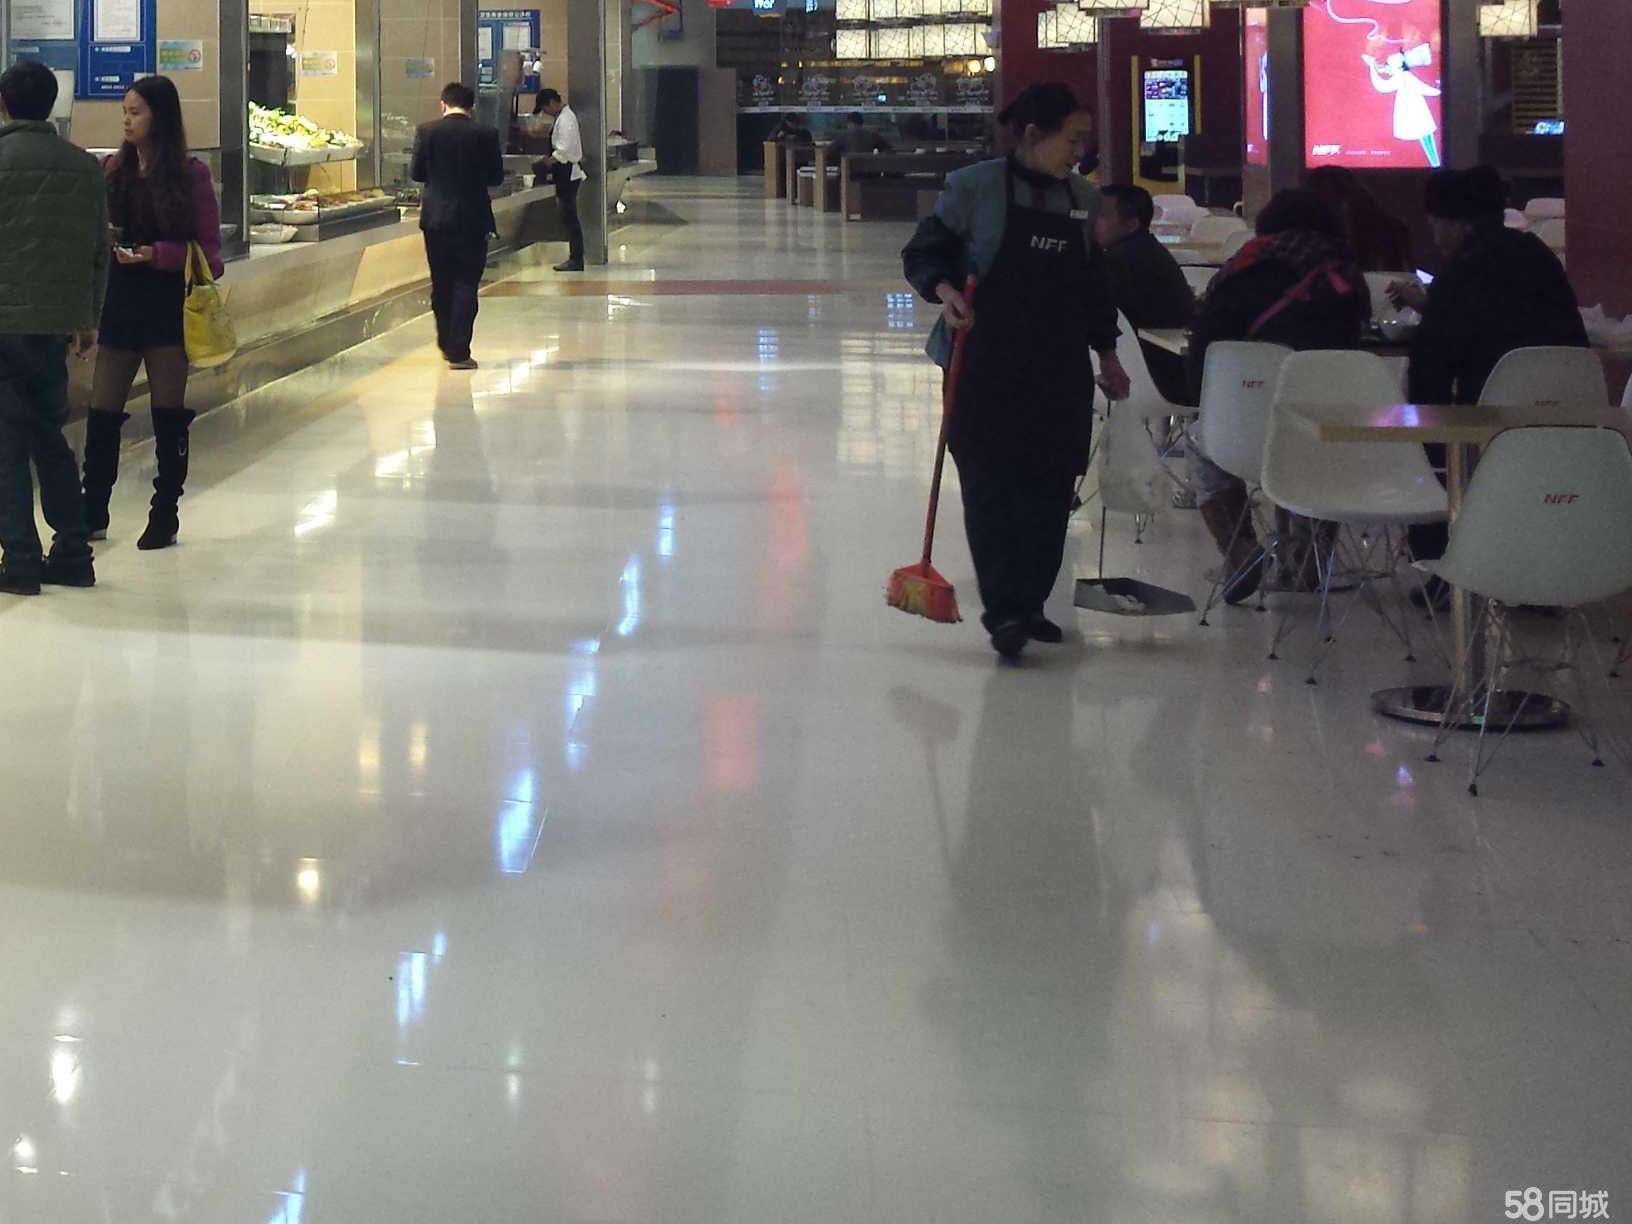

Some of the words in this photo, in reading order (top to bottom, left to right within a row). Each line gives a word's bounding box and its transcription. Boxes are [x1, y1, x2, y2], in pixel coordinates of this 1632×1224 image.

[1312, 144, 1342, 156] NFF
[1030, 235, 1068, 253] NFF
[1543, 492, 1580, 505] NFF
